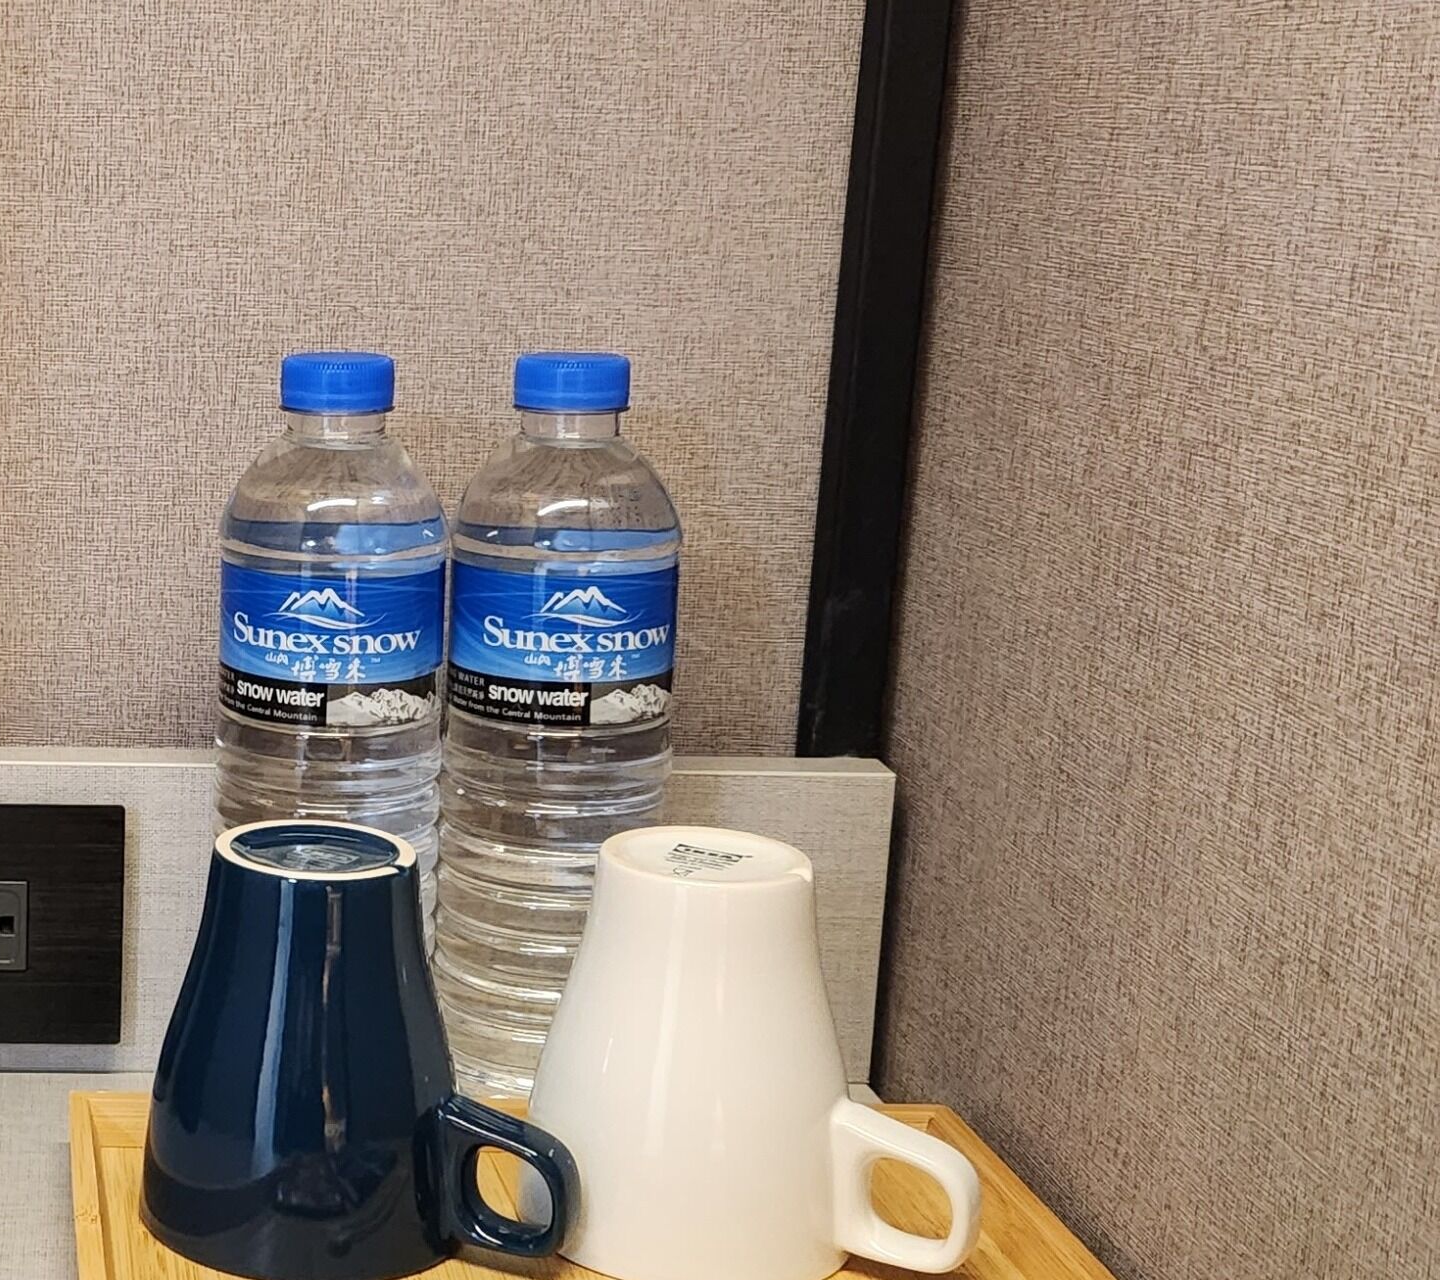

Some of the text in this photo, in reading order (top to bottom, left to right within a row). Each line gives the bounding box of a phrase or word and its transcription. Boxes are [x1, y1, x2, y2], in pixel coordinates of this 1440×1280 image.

[236, 679, 274, 702] snow
[275, 686, 325, 708] water
[488, 683, 535, 706] snow
[536, 688, 589, 708] water
[247, 703, 271, 717] Central
[273, 709, 318, 722] Mountain
[502, 707, 531, 719] Central
[533, 711, 582, 722] Mountain
